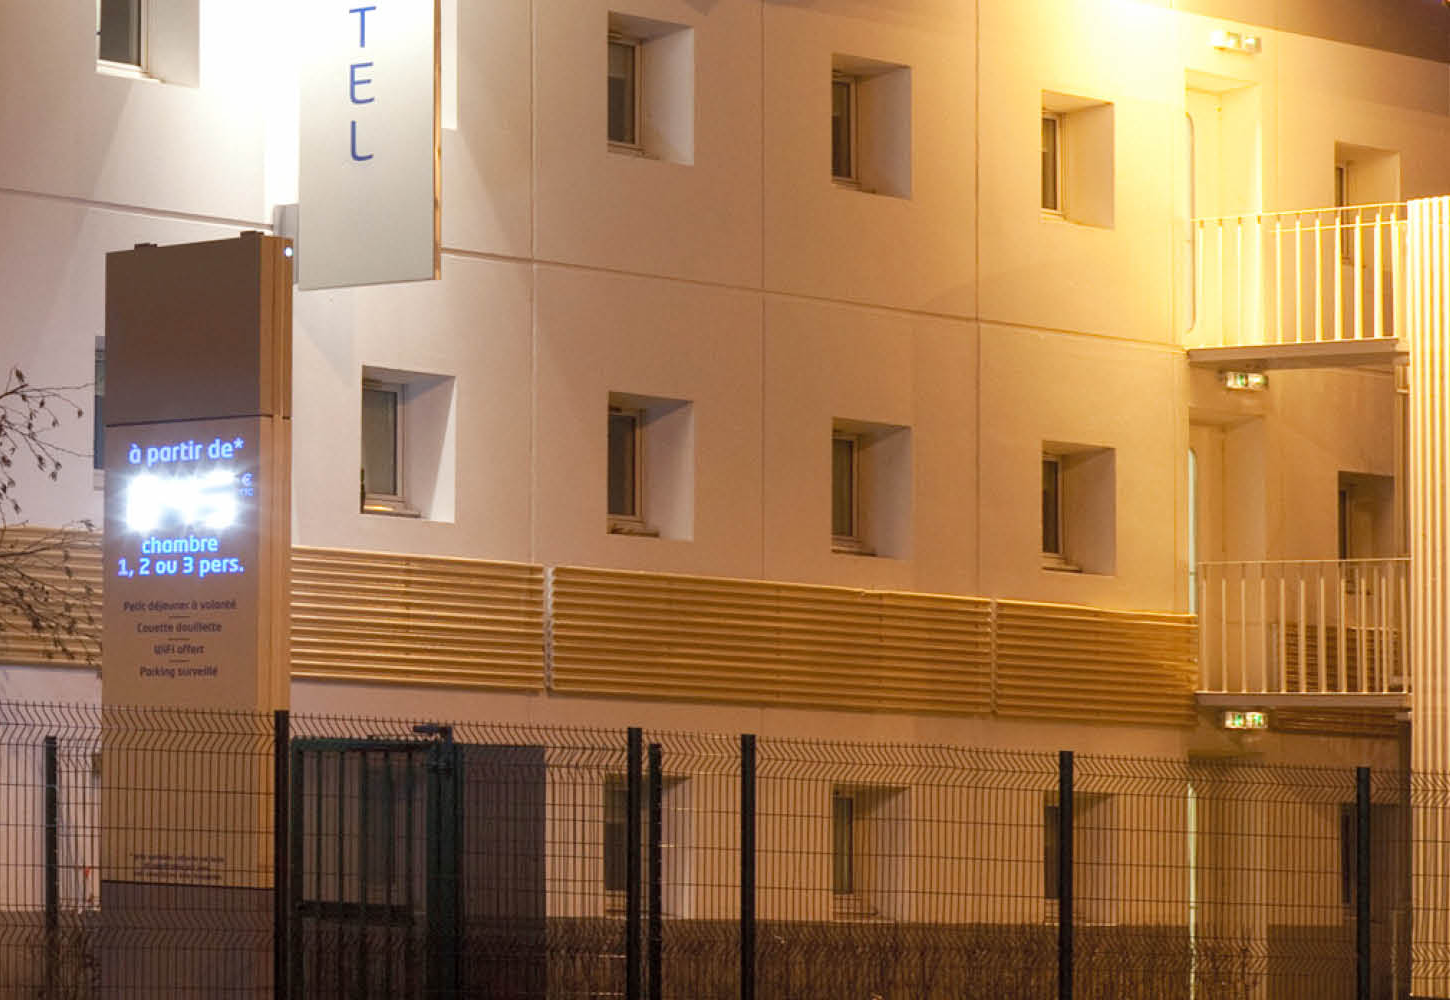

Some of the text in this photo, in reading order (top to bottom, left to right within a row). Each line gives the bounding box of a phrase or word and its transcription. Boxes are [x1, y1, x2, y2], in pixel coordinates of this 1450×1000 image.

[128, 443, 142, 465] à
[147, 440, 202, 468] partir
[142, 535, 218, 555] chambre
[118, 556, 245, 578] 1, 2 ou 3 pers.
[137, 623, 174, 632] Couette
[139, 666, 175, 677] Parking
